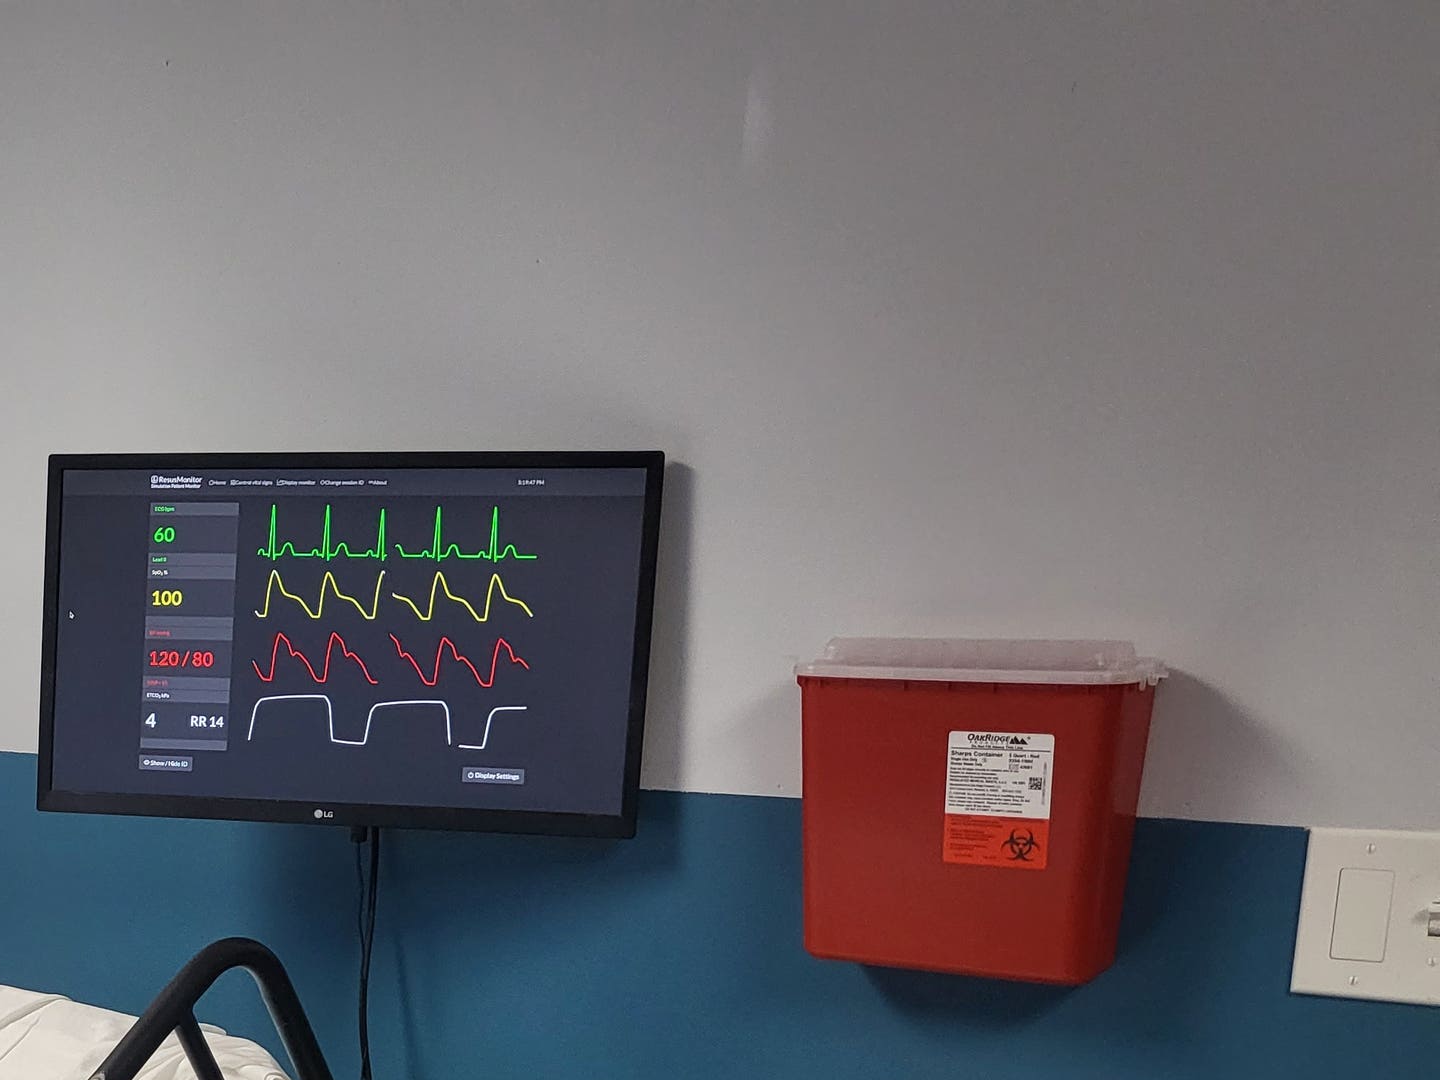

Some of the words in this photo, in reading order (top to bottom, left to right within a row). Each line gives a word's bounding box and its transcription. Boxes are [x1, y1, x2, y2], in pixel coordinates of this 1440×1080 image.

[158, 475, 203, 484] ResusMonitor
[153, 527, 176, 543] 60
[151, 590, 183, 606] 100
[149, 650, 179, 667] 120
[191, 651, 214, 668] 80
[145, 712, 157, 729] 4
[190, 715, 207, 728] RR
[208, 715, 225, 728] 14
[474, 772, 496, 780] Display
[496, 772, 520, 781] Settings
